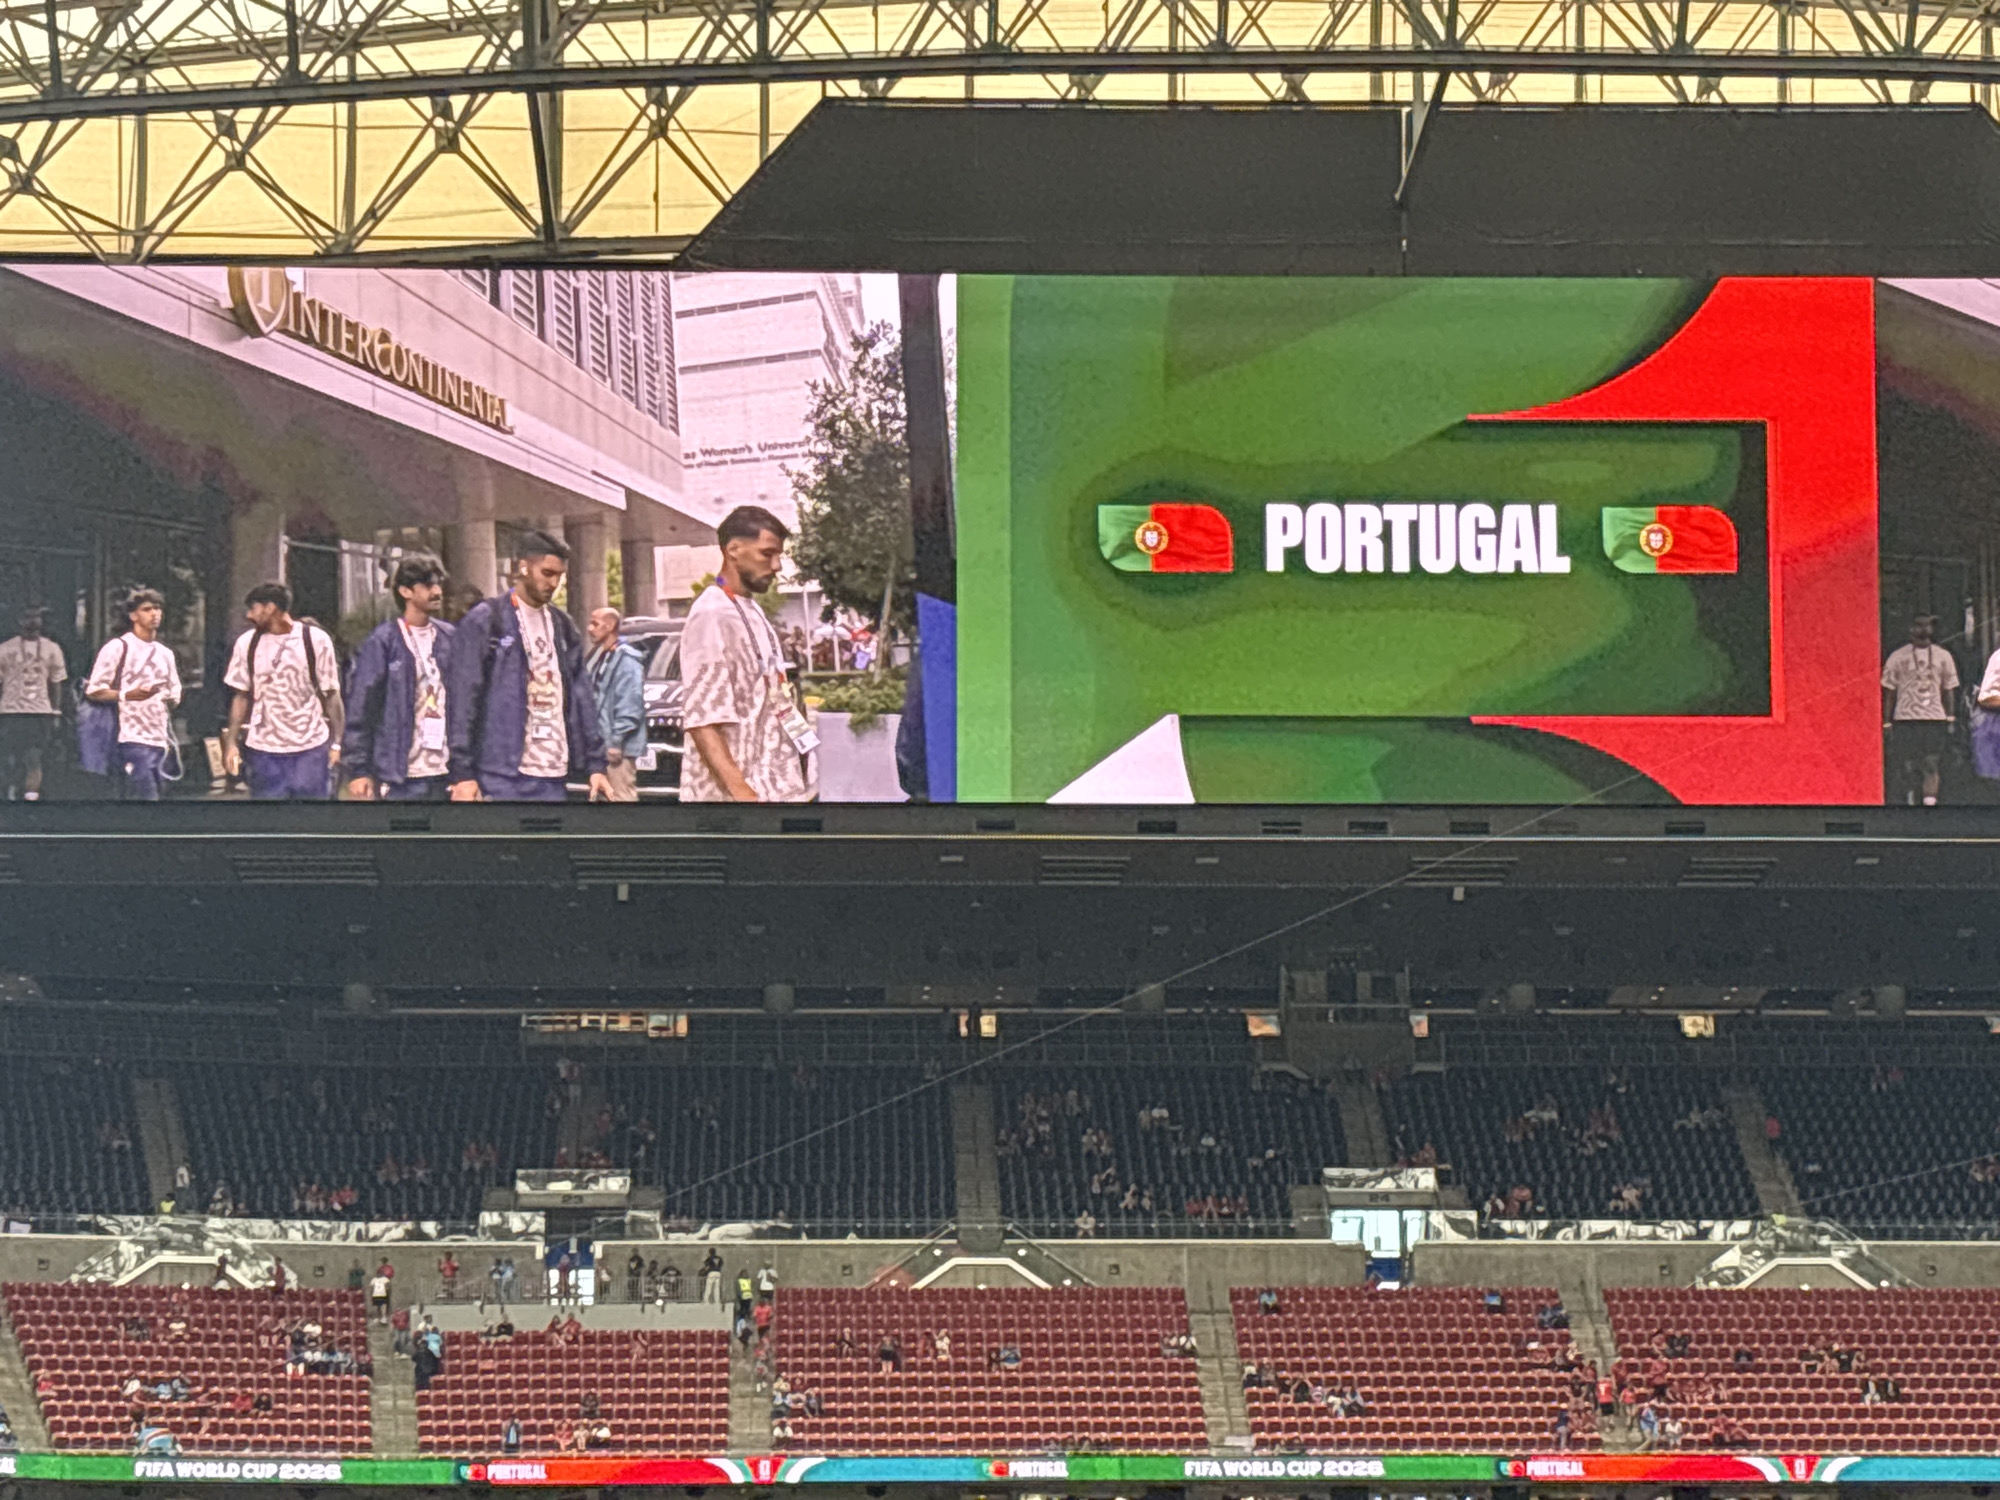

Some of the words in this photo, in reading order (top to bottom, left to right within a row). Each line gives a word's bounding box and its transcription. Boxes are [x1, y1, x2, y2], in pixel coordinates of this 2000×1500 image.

[1265, 502, 1571, 574] PORTUGAL
[134, 1461, 174, 1477] FIFA
[176, 1462, 240, 1478] WORLD
[242, 1463, 278, 1479] CUP
[279, 1463, 342, 1480] 2026
[1184, 1461, 1222, 1477] FIFA
[1223, 1461, 1285, 1477] WORLD
[1287, 1461, 1322, 1477] CUP
[1323, 1461, 1386, 1477] 2026
[1526, 1461, 1585, 1476] PORTUGAL
